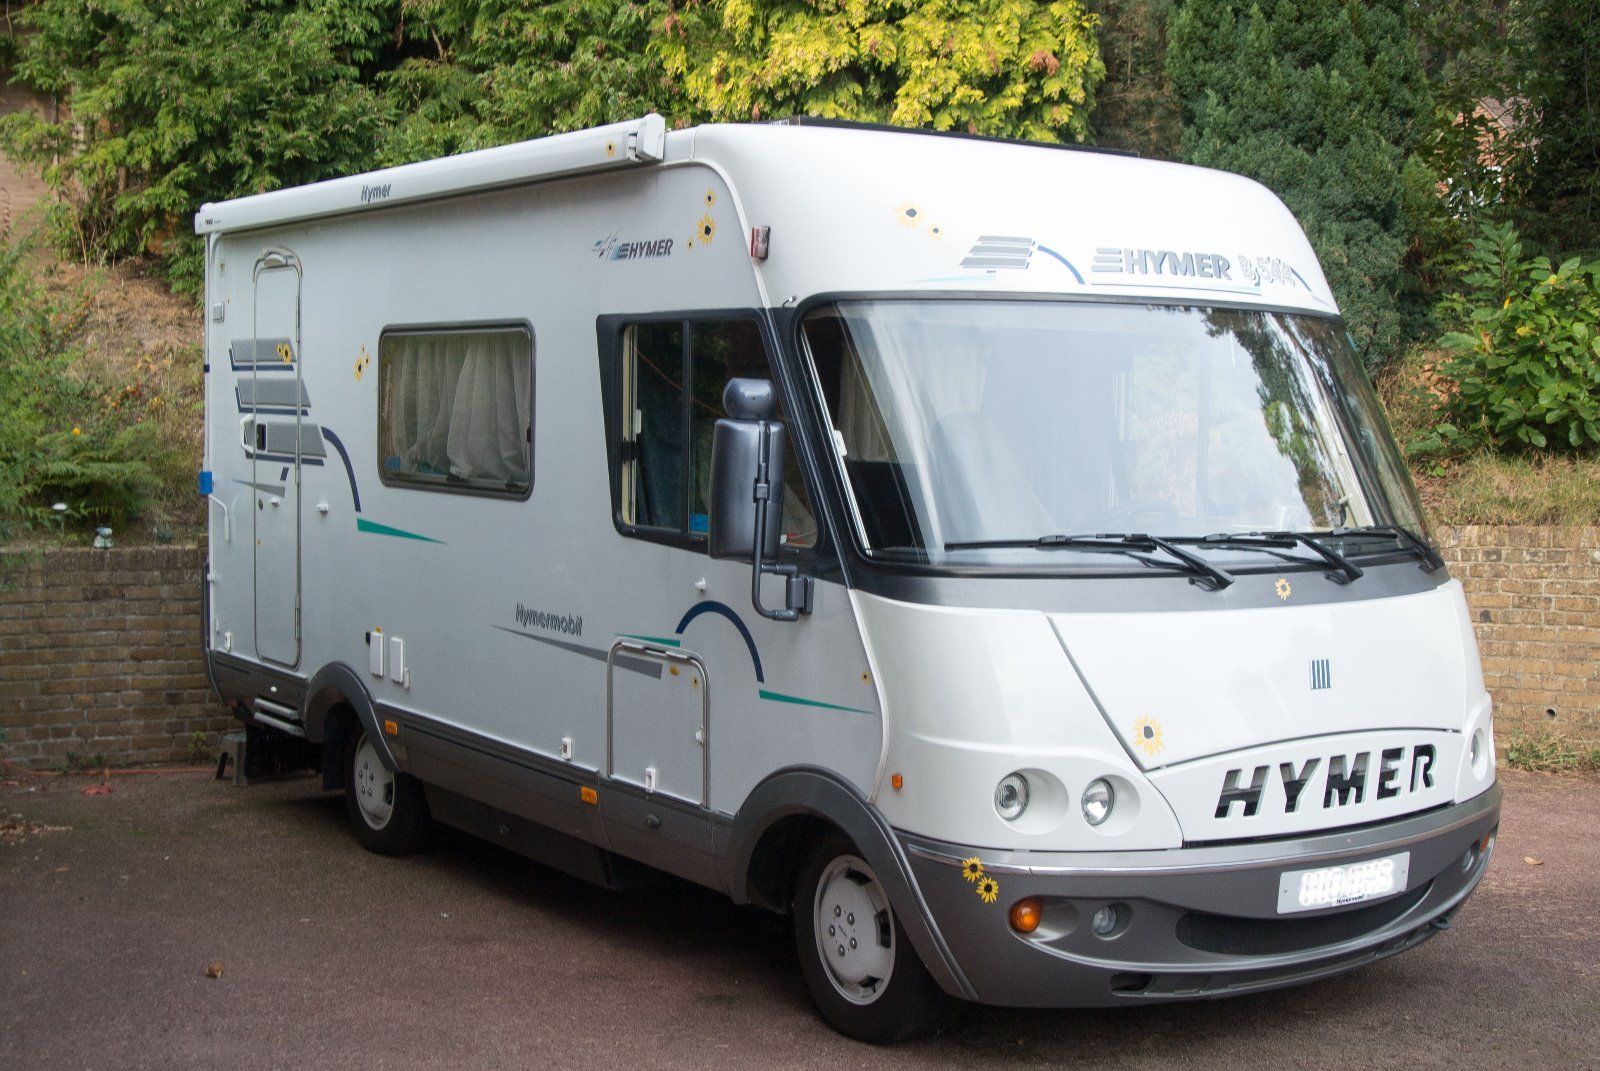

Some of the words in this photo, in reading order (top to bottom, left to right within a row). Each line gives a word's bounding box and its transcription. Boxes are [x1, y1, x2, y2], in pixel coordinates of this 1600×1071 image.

[361, 184, 391, 204] Hymer
[628, 239, 674, 260] HYMER
[1124, 249, 1231, 280] HYMER
[515, 602, 583, 637] Hymermobil
[1214, 743, 1438, 819] HYMER
